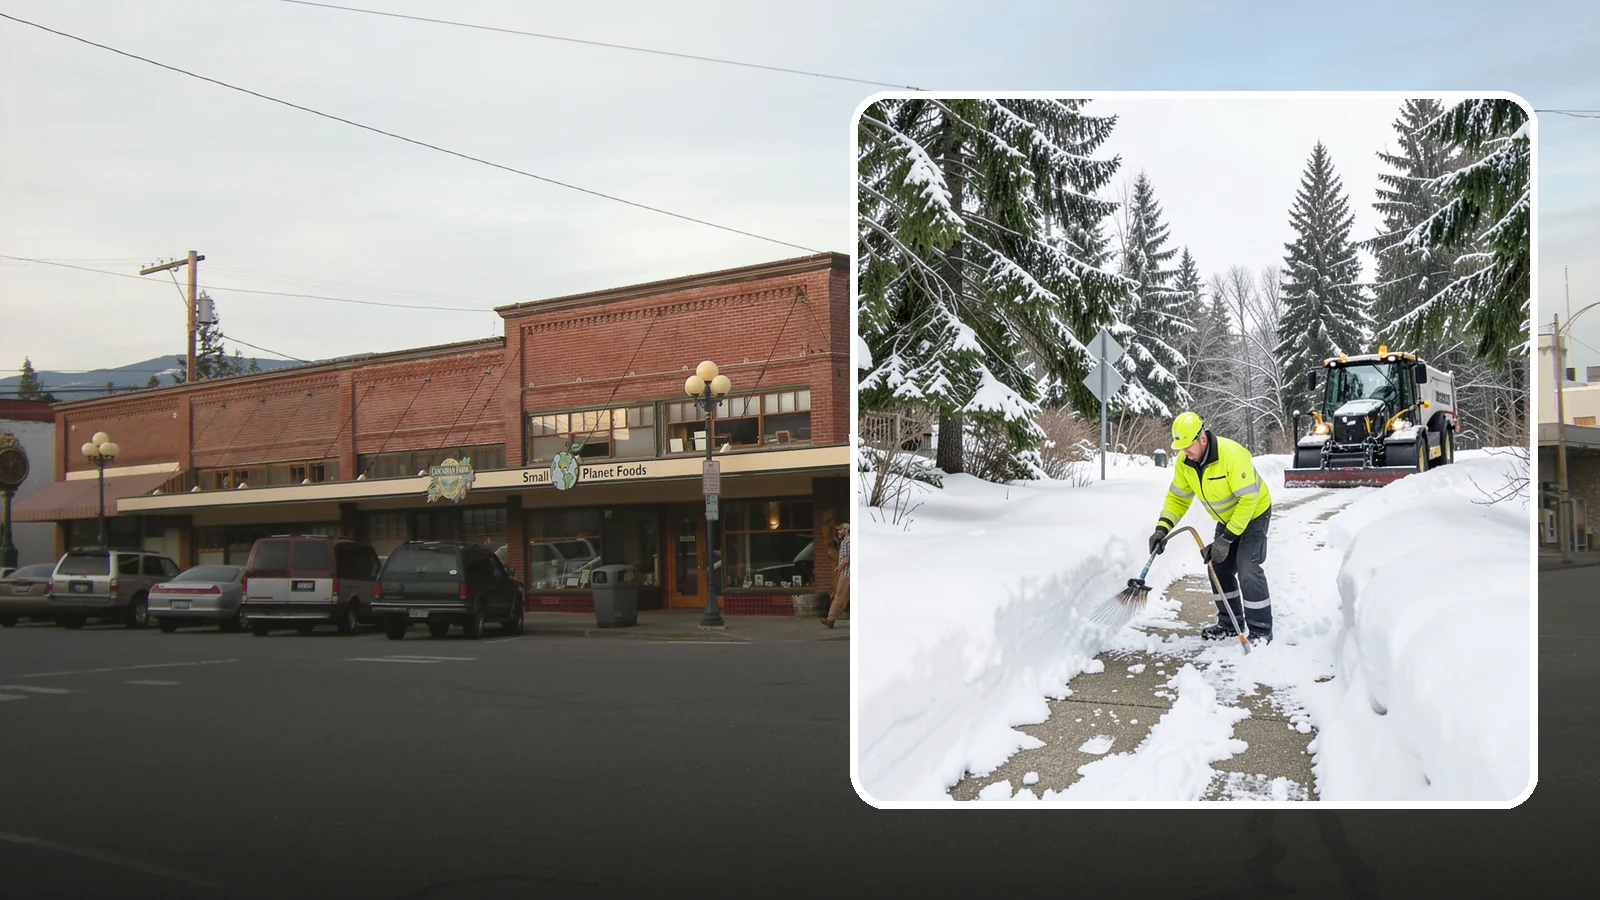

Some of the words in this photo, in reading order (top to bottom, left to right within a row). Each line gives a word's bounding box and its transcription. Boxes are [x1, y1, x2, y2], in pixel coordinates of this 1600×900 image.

[431, 466, 456, 476] CASCADIAN
[456, 465, 469, 475] FARM
[523, 470, 549, 483] Small
[583, 467, 614, 479] Planet
[617, 464, 647, 477] Foods
